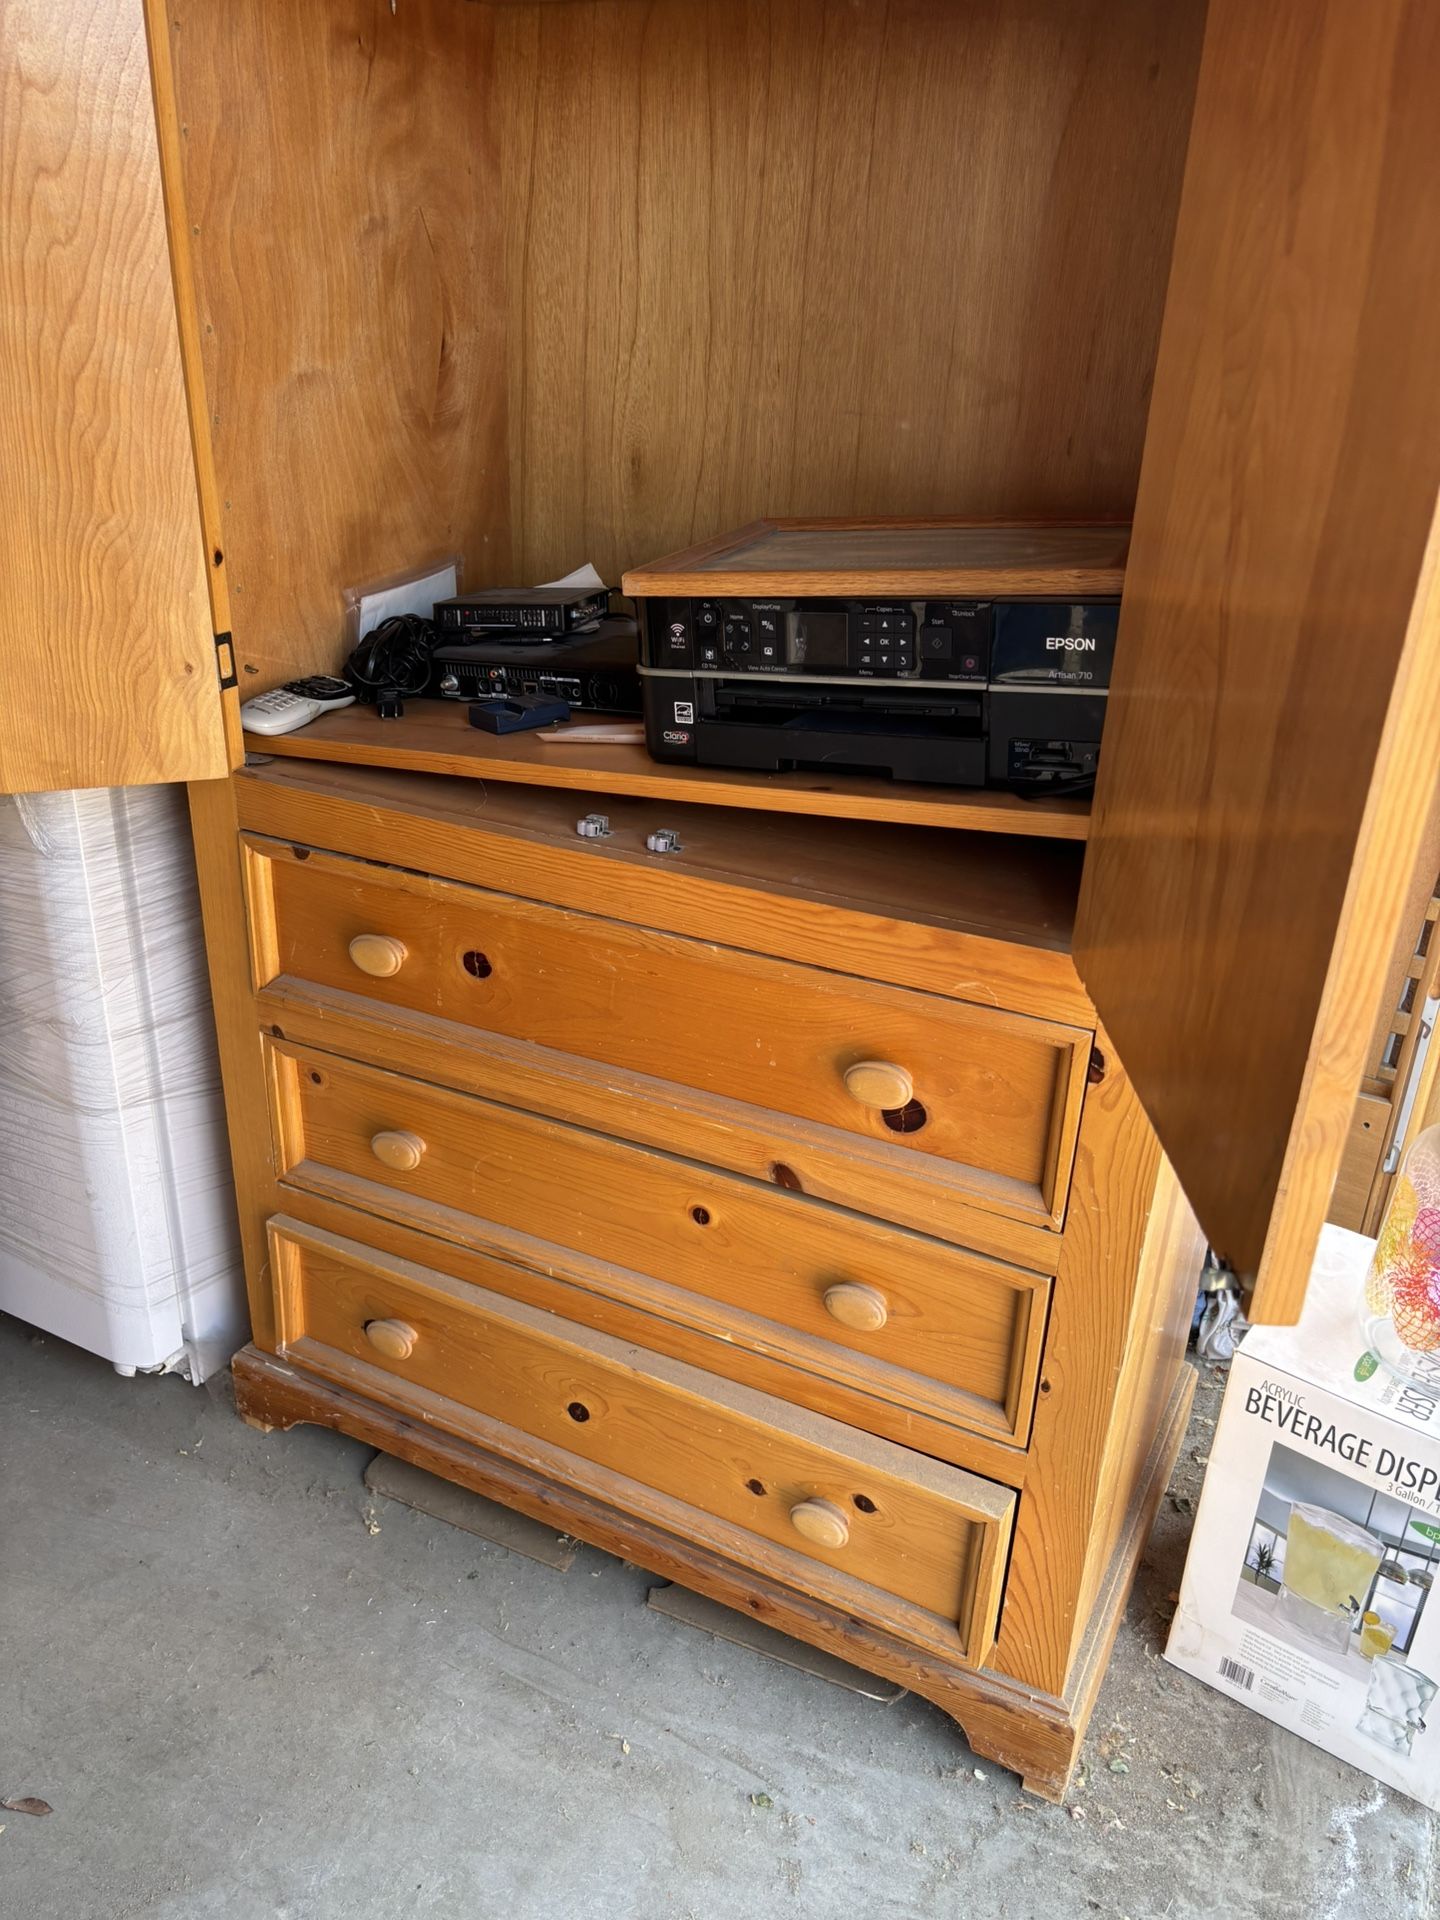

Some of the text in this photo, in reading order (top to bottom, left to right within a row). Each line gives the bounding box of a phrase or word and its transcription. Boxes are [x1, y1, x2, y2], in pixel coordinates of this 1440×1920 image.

[1045, 637, 1096, 651] EPSON
[1048, 671, 1093, 680] Artisan 710
[663, 731, 689, 741] Claria
[1260, 1380, 1306, 1409] ACRYLIC
[1245, 1387, 1373, 1468] BEVERAGE
[1386, 1482, 1394, 1492] 3
[1395, 1485, 1426, 1508] Gallon
